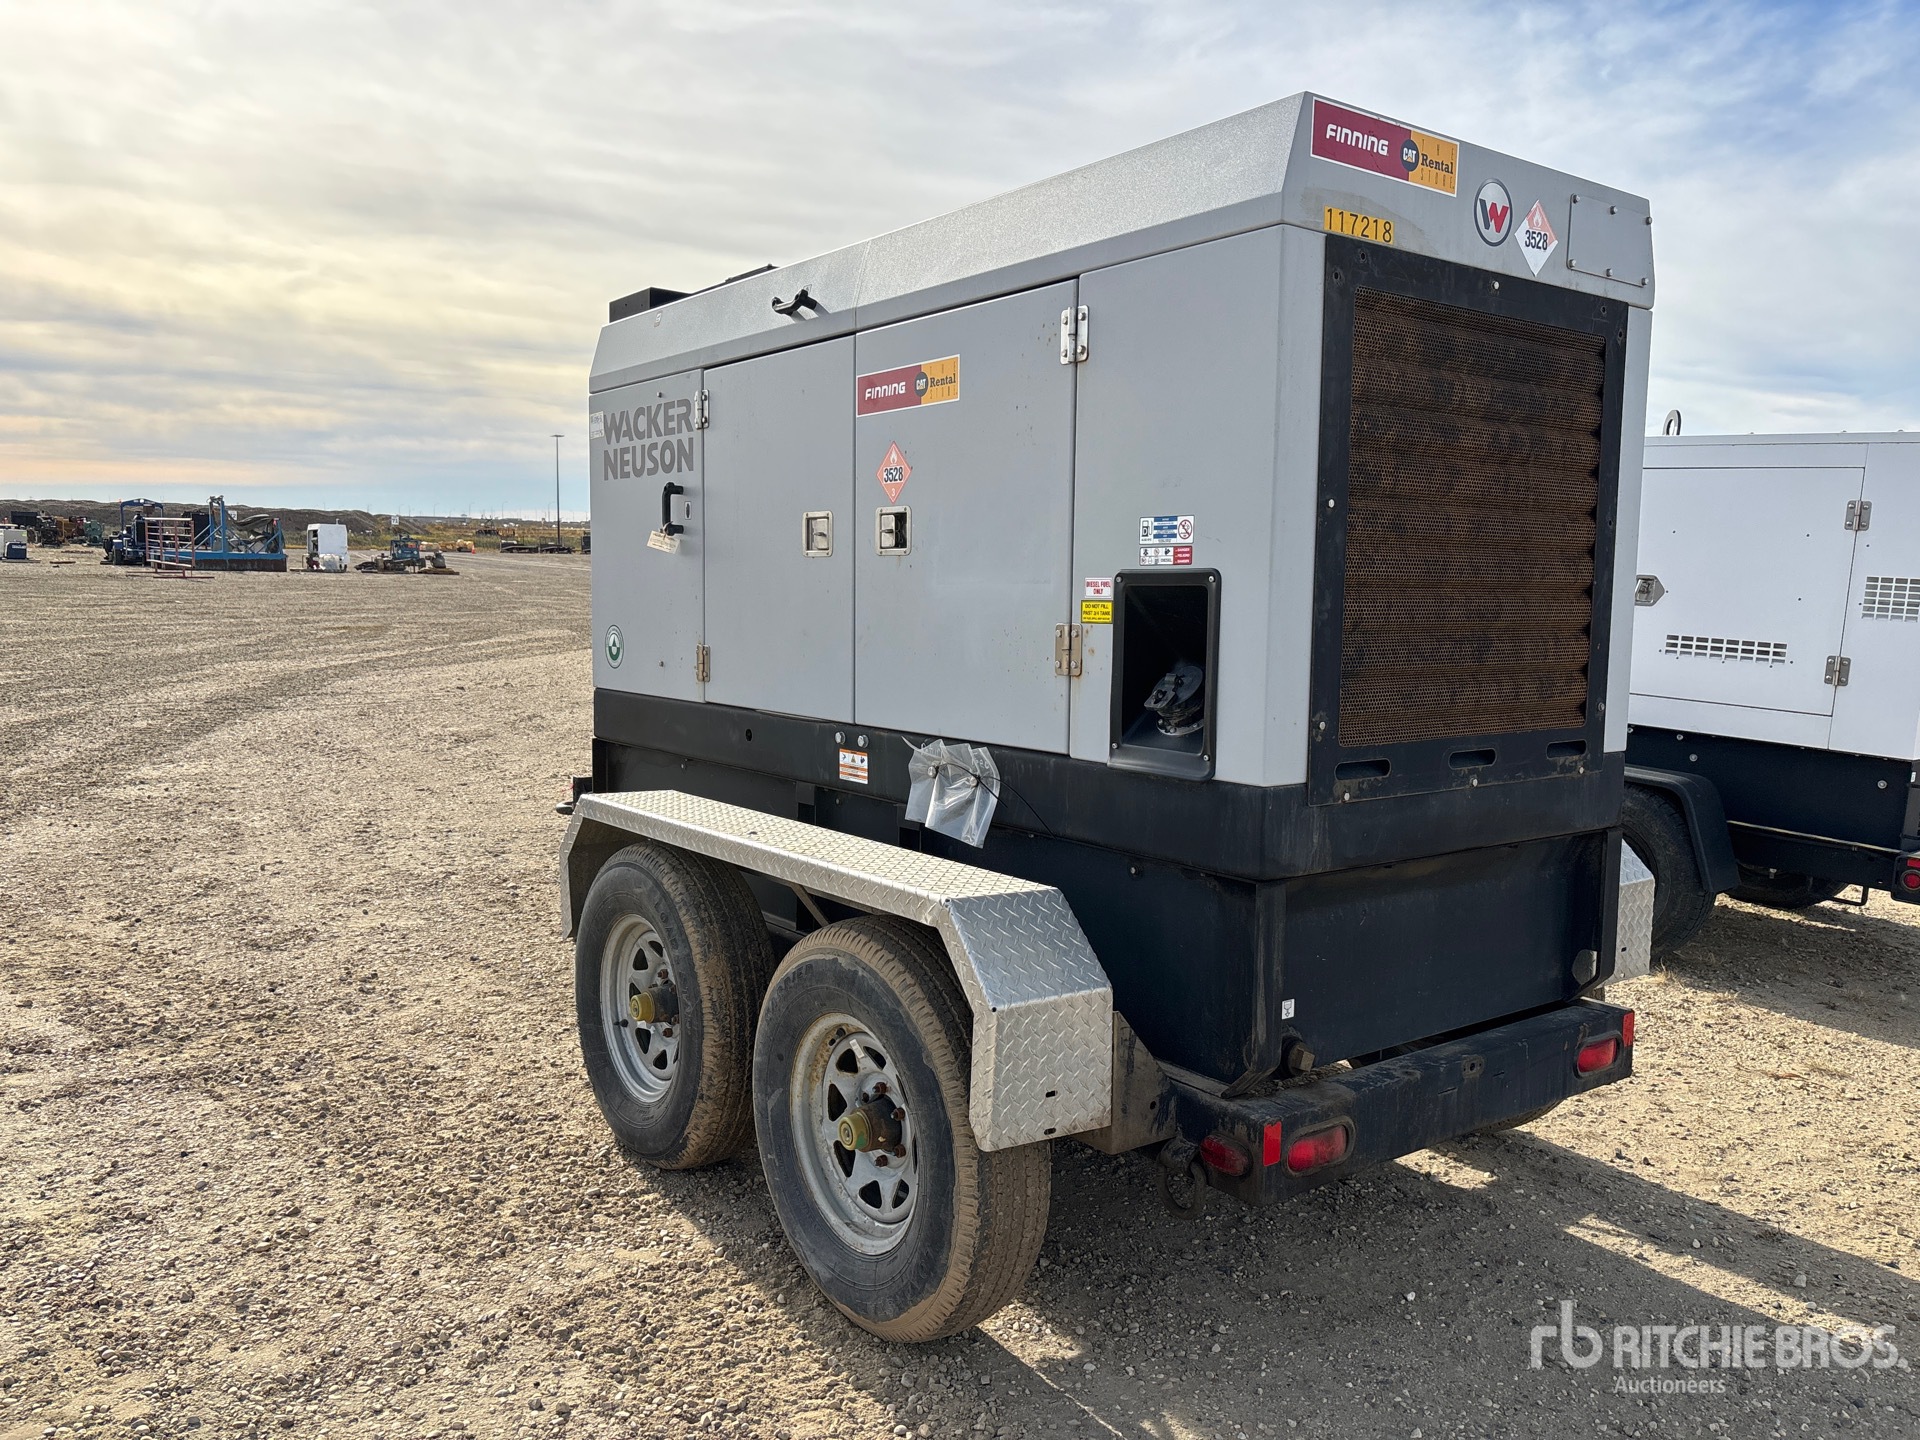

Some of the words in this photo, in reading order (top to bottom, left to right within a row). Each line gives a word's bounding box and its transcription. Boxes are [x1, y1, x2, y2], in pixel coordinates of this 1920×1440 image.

[1326, 123, 1389, 157] FINNING
[1403, 147, 1417, 163] CAT
[1421, 153, 1454, 175] Rental
[1327, 208, 1393, 244] 117218
[1525, 229, 1548, 251] 3528
[916, 379, 927, 391] CAT
[930, 373, 956, 388] Rental
[865, 382, 906, 401] FINNING
[604, 399, 694, 445] WACKER
[604, 437, 694, 481] NEUSON
[884, 466, 904, 483] 3528
[891, 487, 896, 497] 3
